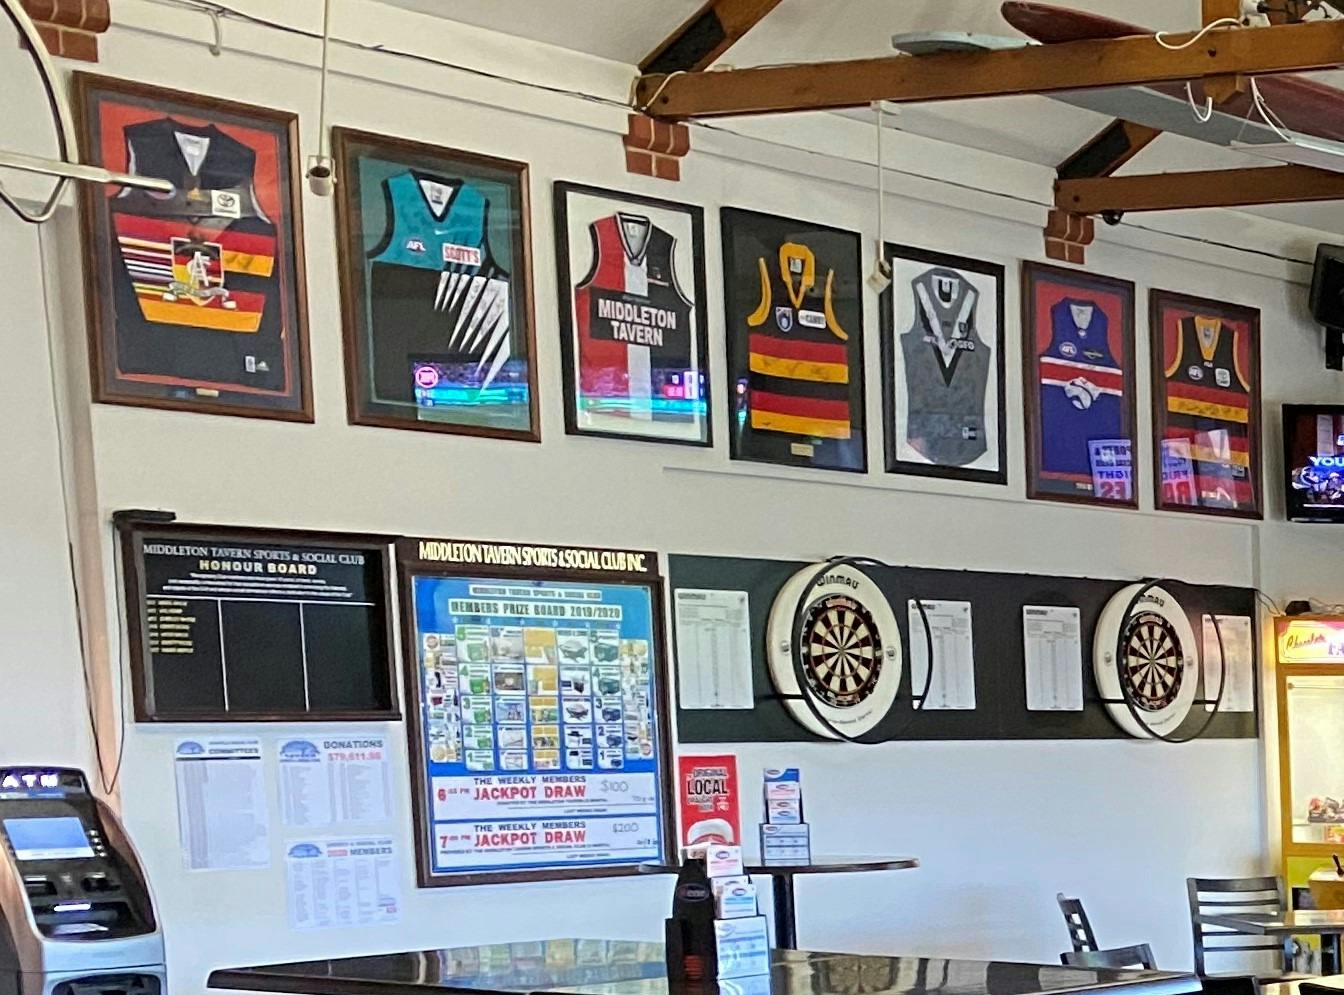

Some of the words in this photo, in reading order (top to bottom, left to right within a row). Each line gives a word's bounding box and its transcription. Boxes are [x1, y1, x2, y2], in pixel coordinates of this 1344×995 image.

[598, 299, 677, 329] MIDDLETON
[611, 321, 663, 346] TAVERN
[143, 544, 208, 556] MIDDLETON
[210, 547, 252, 558] TAVERN
[253, 549, 290, 561] SPORTS
[301, 552, 337, 563] SOCIAL
[338, 554, 365, 565] CLUB
[419, 541, 482, 563] MIDDLETON
[482, 544, 521, 565] TAVERN
[521, 546, 558, 567] SPORTS
[565, 549, 601, 569] SOCIAL
[601, 551, 627, 571] CLUB
[199, 560, 263, 572] HONOUR
[267, 562, 317, 575] BOARD
[451, 601, 499, 614] MEMBERS
[503, 603, 530, 615] PRIZE
[534, 604, 565, 617] BOARD
[570, 606, 620, 618] 2019/2020
[323, 740, 383, 749] DONATIONS
[2, 772, 59, 788] ATM
[473, 777, 492, 785] THE
[498, 776, 536, 785] WEEKLY
[542, 775, 586, 784] MEMBERS
[600, 779, 629, 793] $100
[688, 779, 728, 795] LOCAL
[473, 786, 537, 801] JACKPOT
[544, 785, 586, 798] DRAW
[473, 824, 492, 832] THE
[498, 823, 537, 831] WEEKLY
[542, 821, 586, 829] MEMBERS
[440, 836, 448, 848] 7
[474, 833, 537, 847] JACKPOT
[545, 830, 586, 843] DRAW
